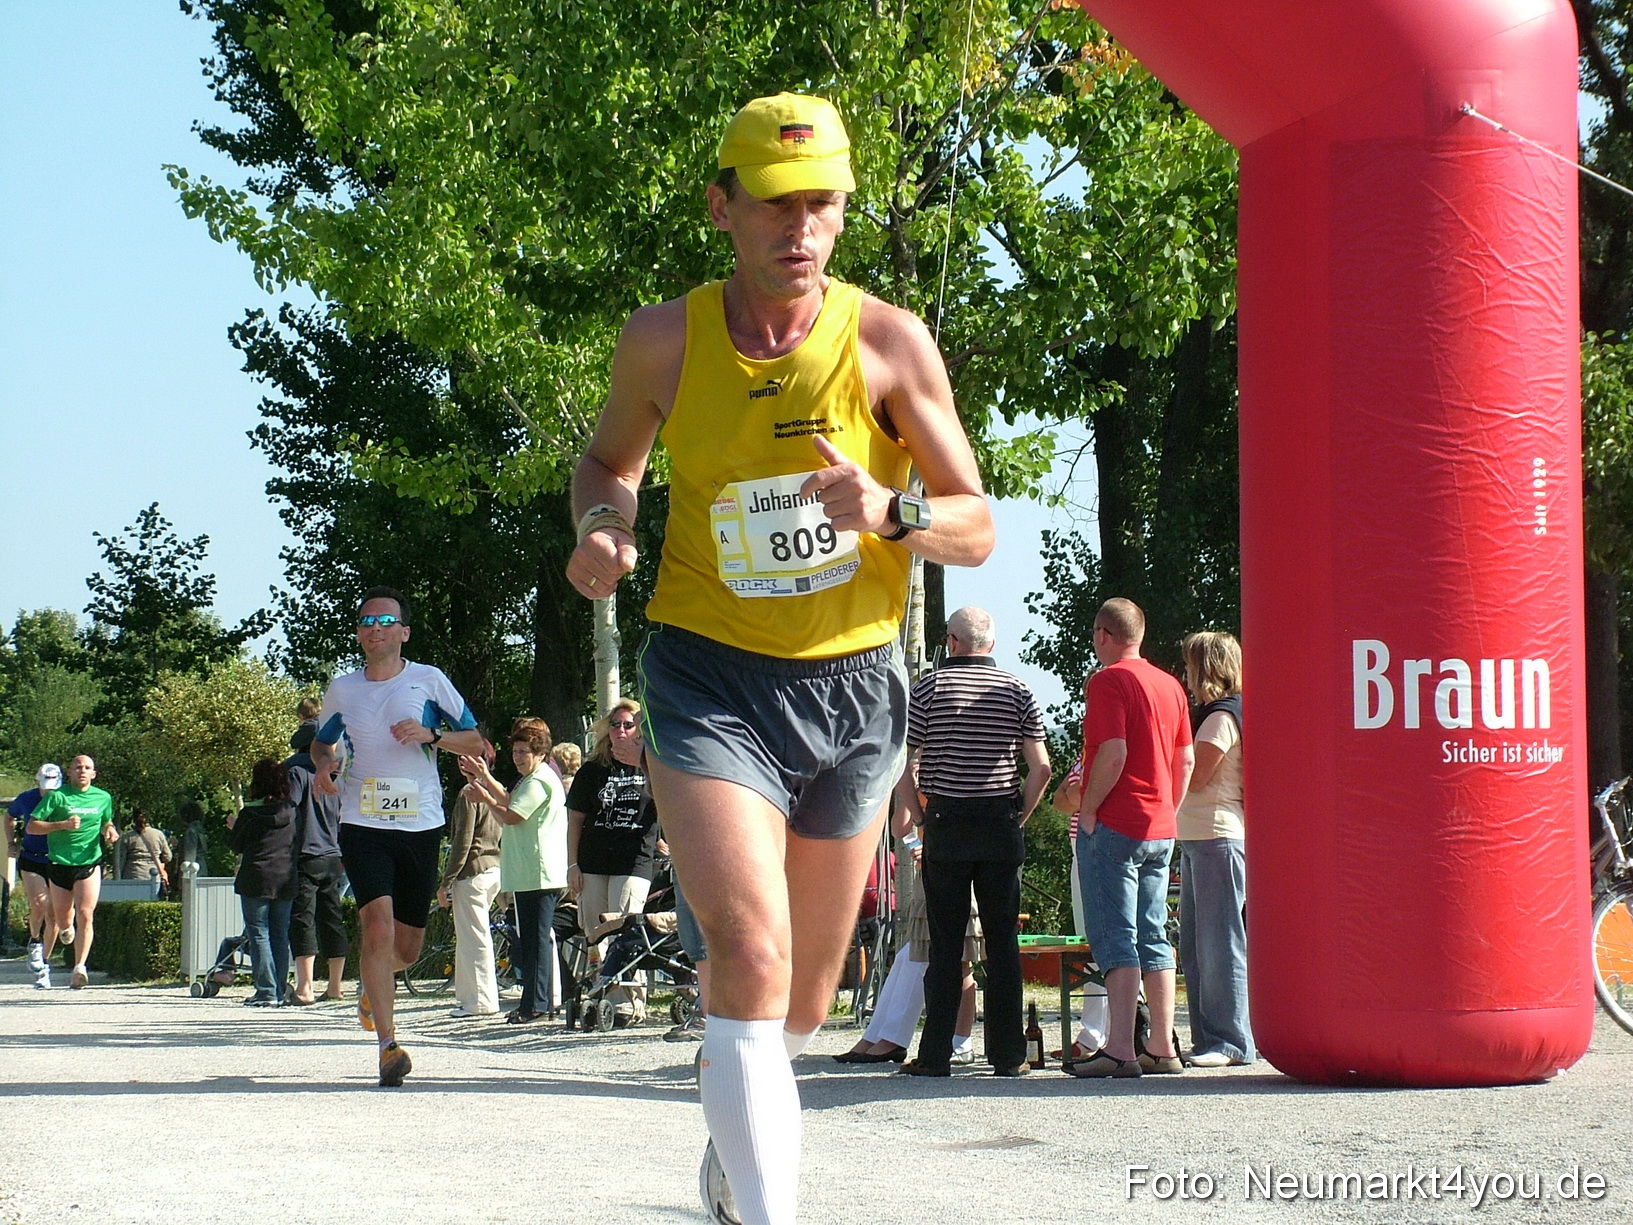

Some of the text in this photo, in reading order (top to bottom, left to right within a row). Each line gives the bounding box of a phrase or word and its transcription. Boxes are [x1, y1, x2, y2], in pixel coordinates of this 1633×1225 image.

[774, 418, 827, 430] SportGruppe
[774, 427, 828, 439] Neunkirchen
[1532, 457, 1547, 497] 1929
[720, 530, 730, 545] A
[769, 522, 837, 562] 809
[811, 560, 859, 584] PFLEIDERER
[1353, 639, 1551, 730] Braun
[1442, 739, 1564, 763] Sicher ist sicher
[376, 782, 391, 791] Udo
[382, 797, 408, 810] 241
